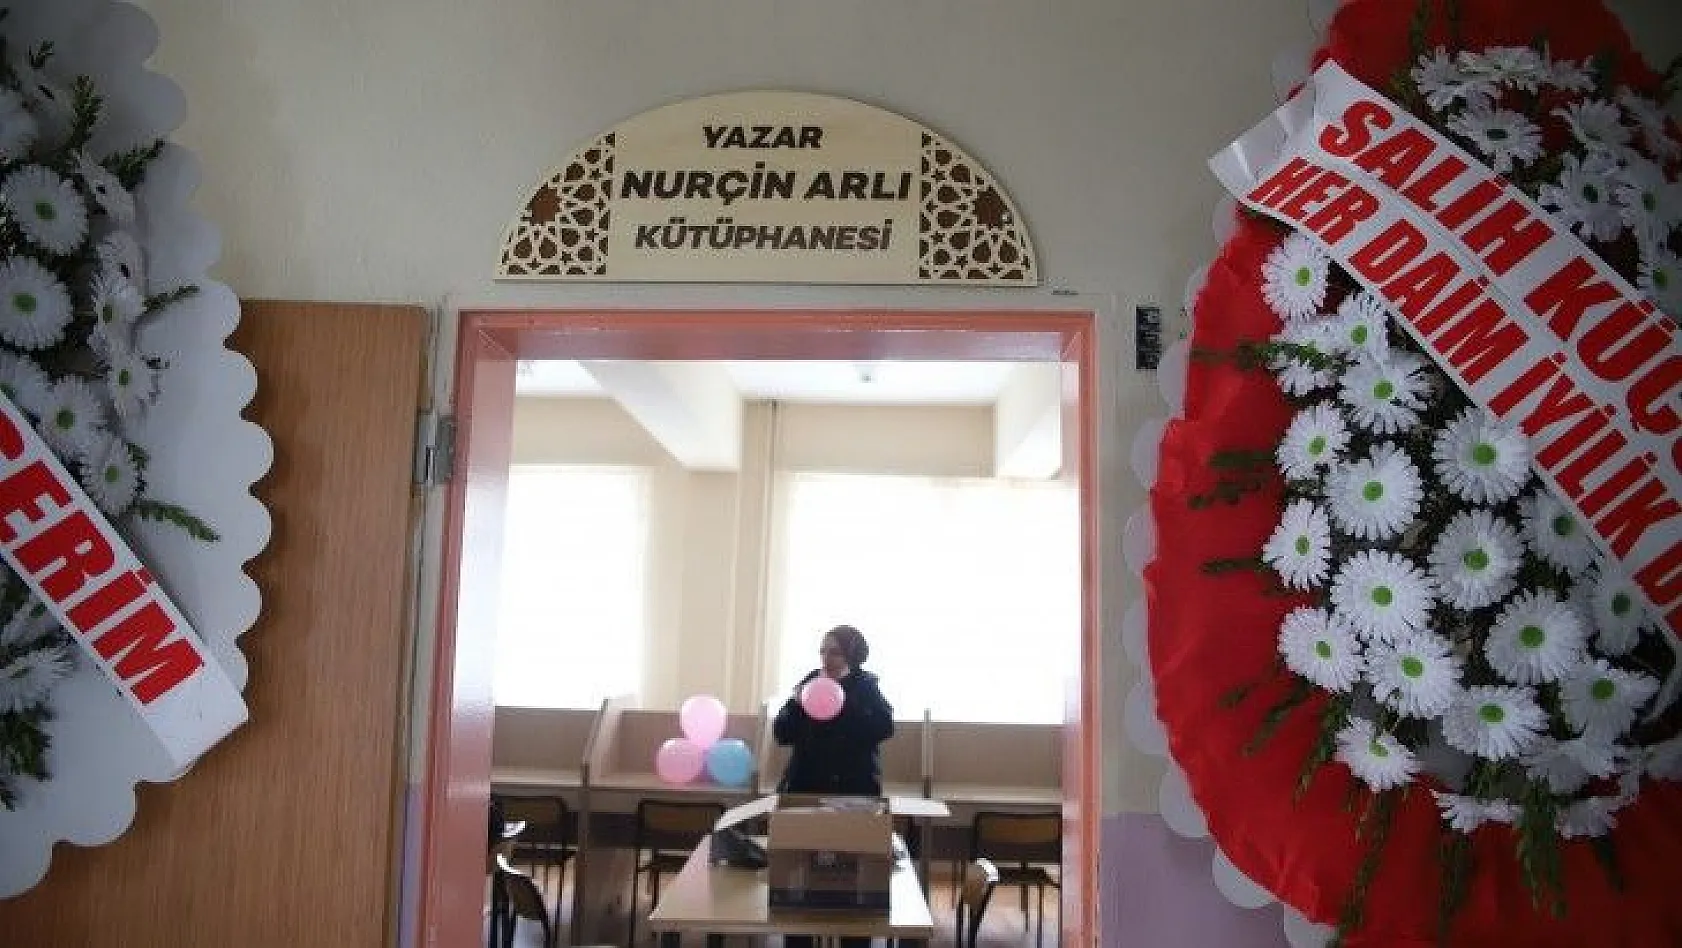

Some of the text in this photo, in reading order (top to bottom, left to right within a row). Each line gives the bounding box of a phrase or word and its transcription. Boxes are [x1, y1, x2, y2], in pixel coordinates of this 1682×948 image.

[620, 161, 913, 205] NURÇİN ARLI
[702, 125, 823, 149] YAZAR
[635, 217, 894, 251] KÜTÜPHANESİ
[1318, 101, 1682, 476] SALİH KÜÇ
[1247, 156, 1381, 245] HER
[1348, 218, 1530, 386] DAİM
[1486, 351, 1682, 561] İYİLİK
[0, 408, 206, 706] ERİM
